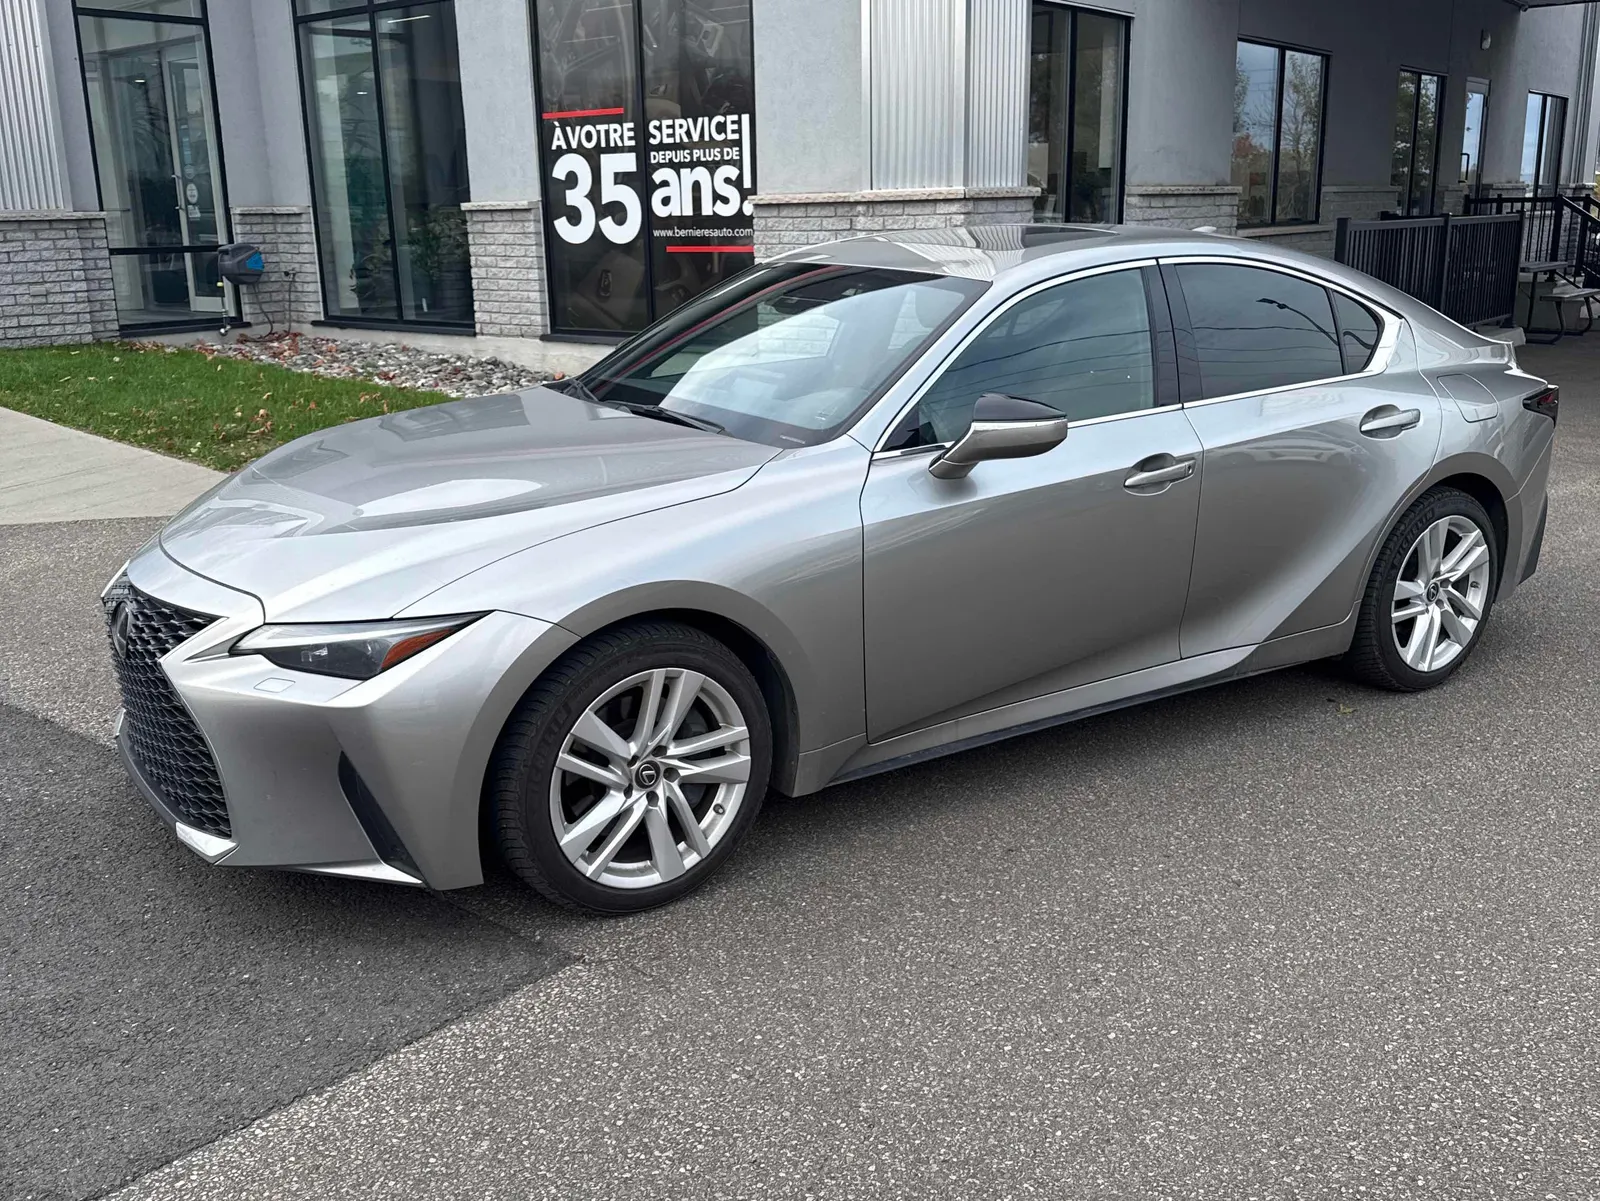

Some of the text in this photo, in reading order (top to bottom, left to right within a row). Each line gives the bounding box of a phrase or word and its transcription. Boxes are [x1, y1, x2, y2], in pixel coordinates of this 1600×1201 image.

[551, 115, 740, 150] À VOTRE SERVICE
[650, 146, 740, 163] DEPUIS PLUS DE
[552, 153, 642, 244] 35
[653, 226, 753, 237] www.bernieresauto.com
